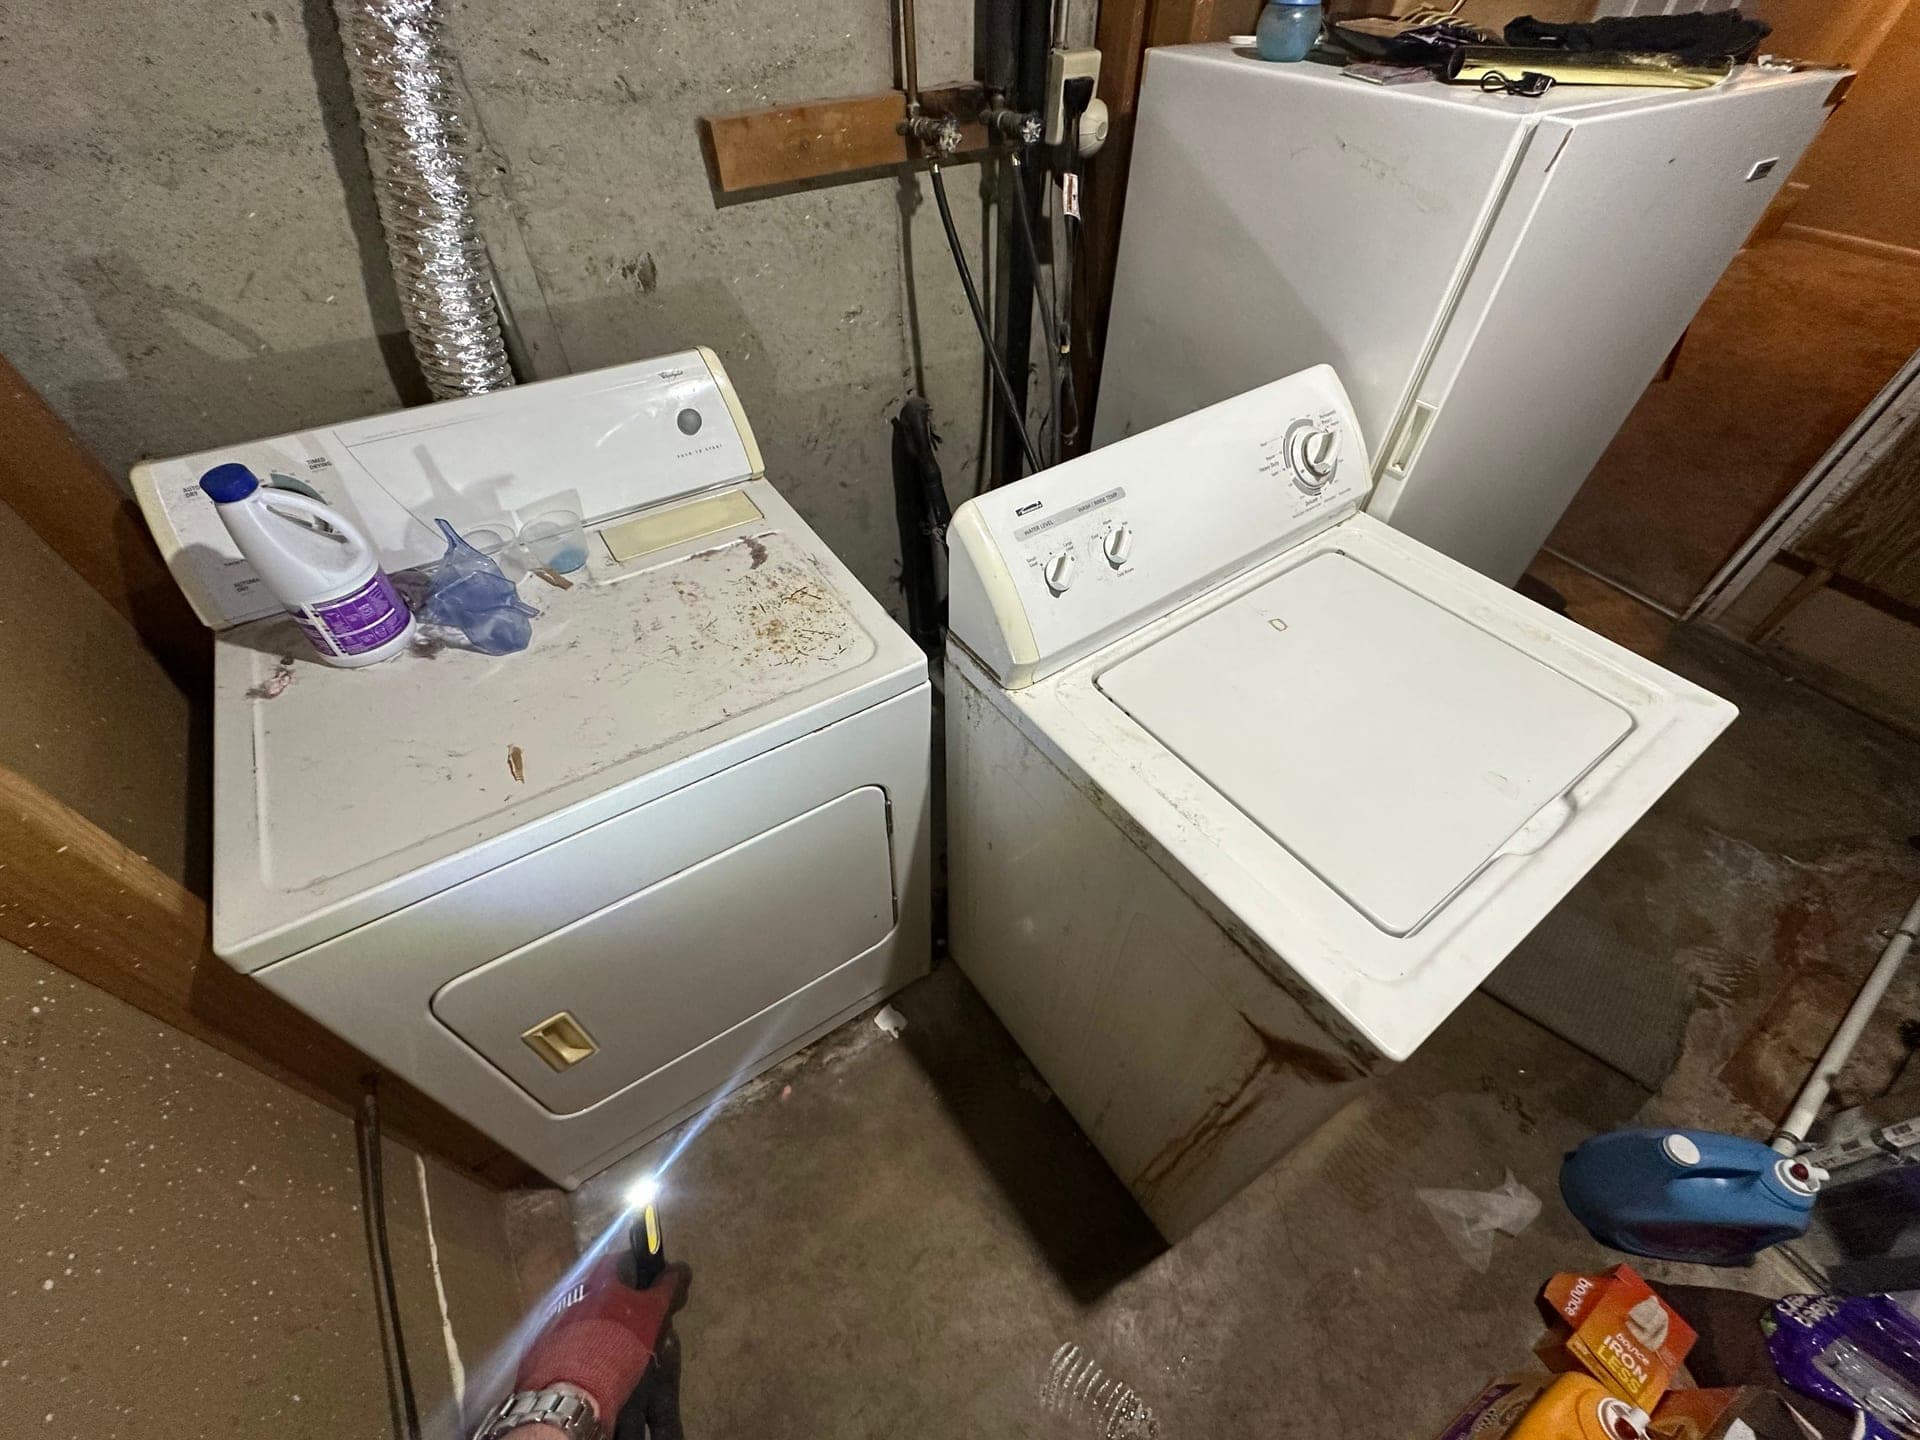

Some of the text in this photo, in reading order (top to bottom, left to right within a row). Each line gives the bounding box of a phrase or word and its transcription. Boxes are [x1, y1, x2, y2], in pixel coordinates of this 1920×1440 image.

[1024, 520, 1054, 536] WATER LEVEL
[1564, 1277, 1594, 1317] bounce
[1597, 1344, 1640, 1394] LESS
[1603, 1335, 1648, 1384] IRON
[1615, 1333, 1650, 1366] bounce
